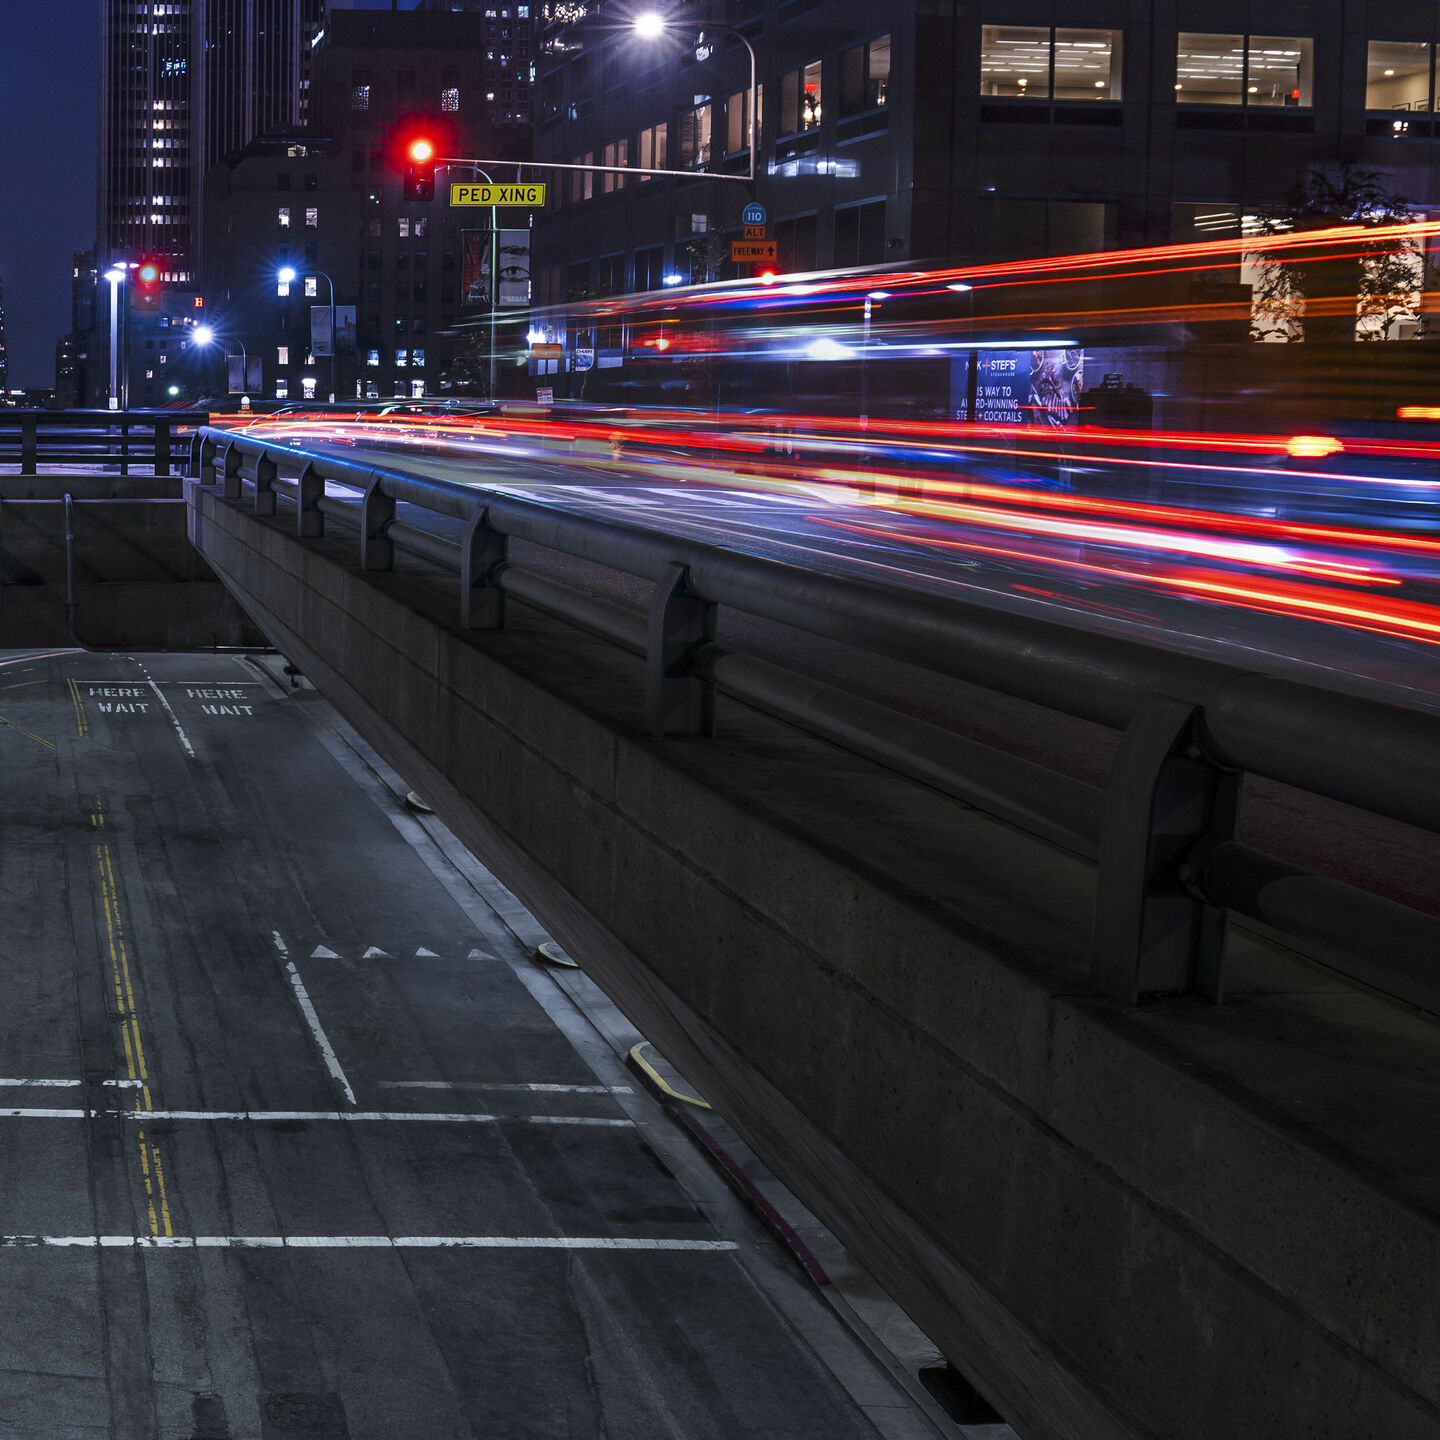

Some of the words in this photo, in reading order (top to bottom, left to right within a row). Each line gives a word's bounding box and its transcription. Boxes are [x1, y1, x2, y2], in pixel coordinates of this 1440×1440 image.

[458, 188, 492, 202] PED
[498, 188, 537, 202] XING
[747, 211, 762, 222] 110
[745, 227, 765, 237] ALT
[733, 247, 765, 257] FREEWAY
[965, 360, 982, 371] NK
[985, 386, 1000, 397] WAY
[1002, 386, 1012, 397] TO
[983, 411, 1023, 422] COCKTAILS
[89, 687, 148, 697] HERE
[186, 688, 248, 699] HERE
[97, 702, 149, 713] WAIT
[201, 704, 254, 716] WAIT
